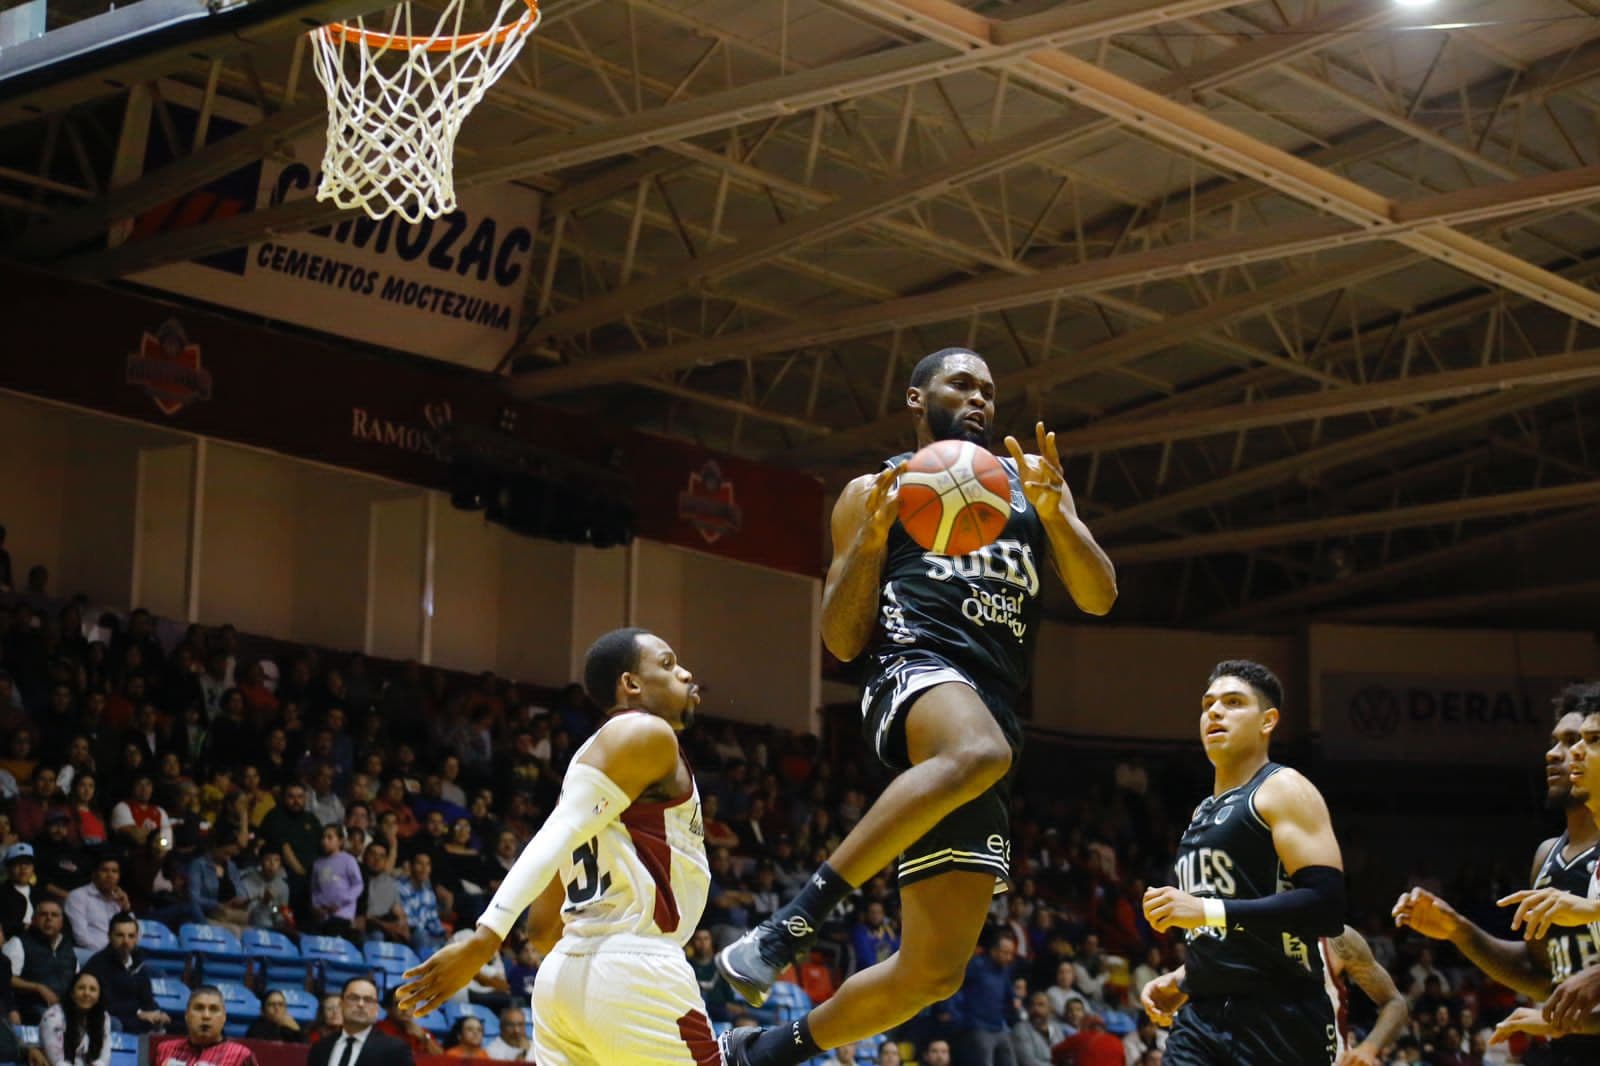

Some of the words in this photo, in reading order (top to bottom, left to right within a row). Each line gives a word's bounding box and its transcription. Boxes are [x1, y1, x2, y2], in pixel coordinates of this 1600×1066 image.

[271, 163, 531, 286] CMOZAC
[257, 243, 379, 294] CEMENTOS
[381, 276, 511, 330] MOCTEZUMA
[1408, 689, 1540, 725] DERAL
[1174, 848, 1236, 895] OLES
